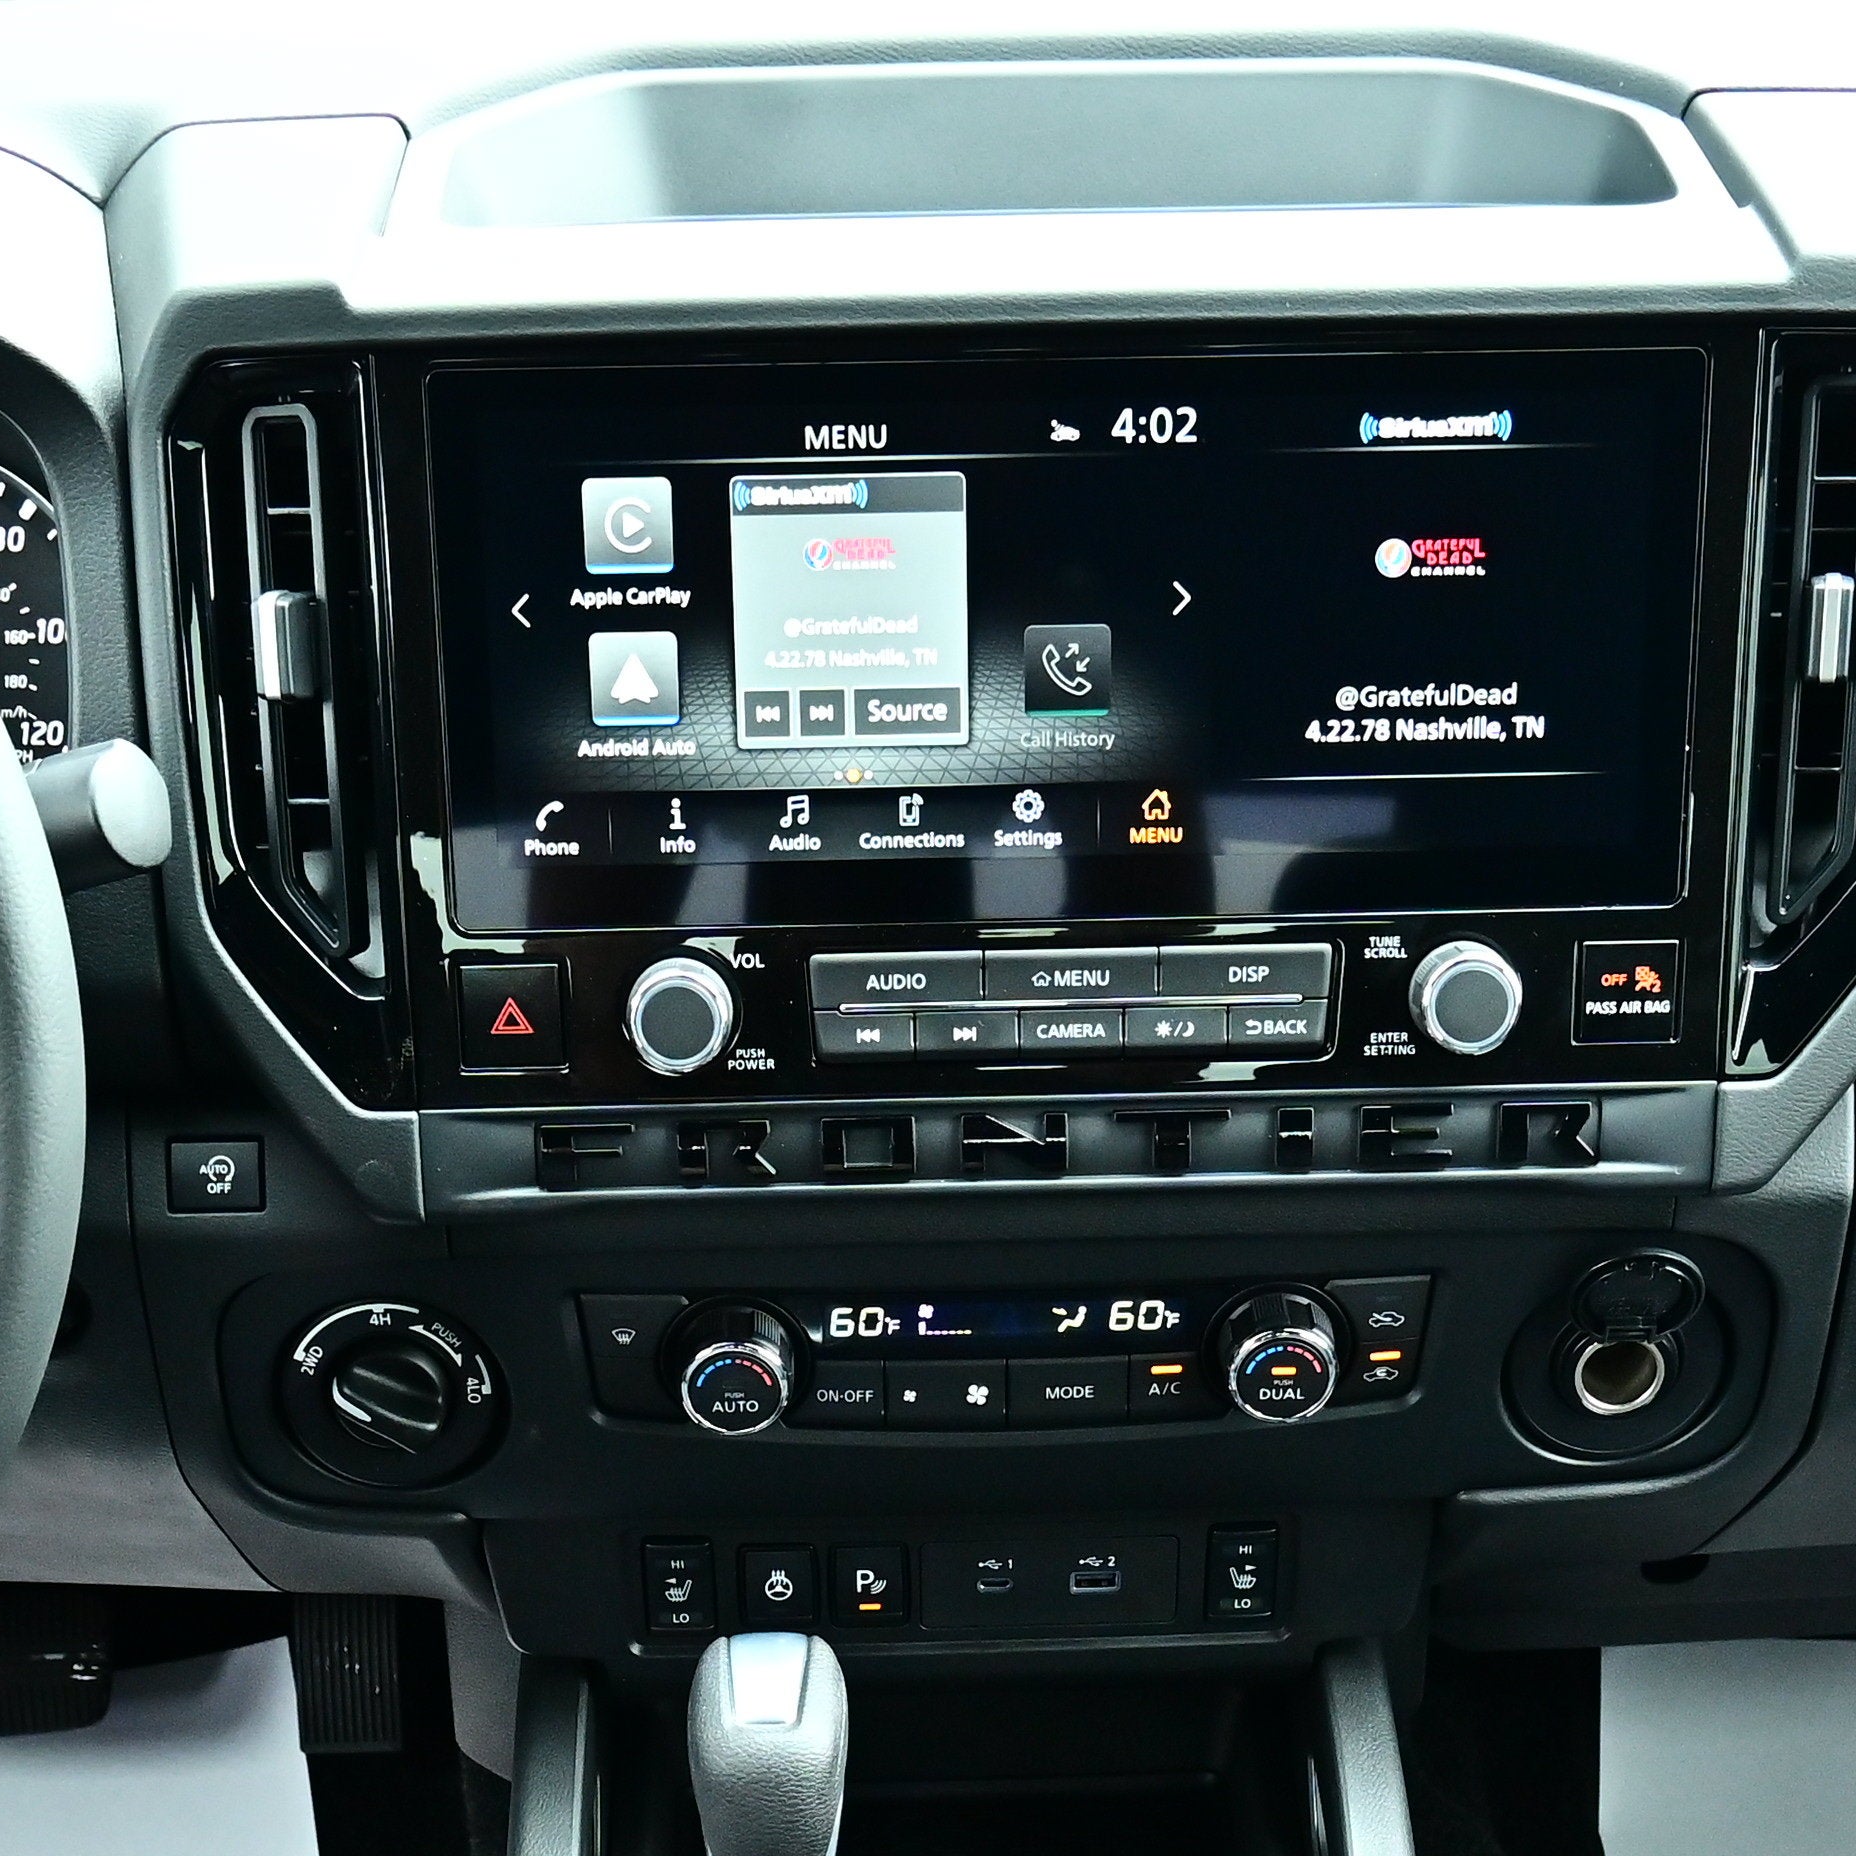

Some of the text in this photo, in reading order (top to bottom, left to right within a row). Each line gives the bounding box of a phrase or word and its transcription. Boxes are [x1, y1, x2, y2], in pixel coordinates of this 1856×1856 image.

[1111, 406, 1198, 444] 4:02
[804, 425, 888, 450] MENU
[1427, 551, 1472, 565] DEAD
[570, 586, 690, 608] Apple CarPlay
[4, 630, 28, 645] 160
[36, 617, 68, 644] 10
[912, 648, 937, 665] TN
[4, 675, 27, 689] 180
[1335, 682, 1518, 710] @GratefulDead
[867, 699, 948, 723] Source
[20, 720, 64, 746] 120
[1305, 716, 1545, 743] 4.22.78 Nashville, TN
[577, 737, 696, 758] Android Auto
[1020, 728, 1115, 751] Call History
[769, 832, 821, 852] Audio
[859, 829, 965, 849] Connections
[993, 826, 1063, 848] Settings
[1129, 825, 1183, 844] MENU
[524, 838, 579, 857] Phone
[660, 835, 696, 855] Info
[1368, 935, 1401, 947] TUNE
[1364, 946, 1408, 959] SCROLL
[730, 953, 765, 970] VOL
[866, 973, 927, 991] AUDIO
[1054, 967, 1110, 988] MENU
[1228, 965, 1270, 984] DISP
[1601, 973, 1628, 987] OFF
[1585, 1000, 1670, 1015] PASS AIR BAG
[1036, 1022, 1106, 1041] CAMERA
[1263, 1018, 1308, 1037] BACK
[1370, 1032, 1408, 1045] ENTER
[735, 1048, 766, 1060] PUSH
[1363, 1043, 1417, 1057] SETTING
[727, 1058, 776, 1072] POWER
[535, 1101, 1602, 1190] FRONTIER
[199, 1164, 229, 1175] AUTO
[206, 1182, 231, 1194] OFF
[369, 1312, 391, 1326] 4H
[431, 1322, 462, 1348] PUSH
[300, 1345, 324, 1376] 2WD
[466, 1377, 482, 1404] 4LO
[1045, 1385, 1094, 1400] MODE
[1148, 1381, 1182, 1397] A/C
[1259, 1387, 1306, 1401] DUAL
[712, 1400, 759, 1414] AUTO
[1238, 1544, 1253, 1556] HI
[671, 1558, 685, 1569] HI
[1007, 1559, 1013, 1570] 1
[1107, 1556, 1116, 1567] 2
[1233, 1597, 1251, 1609] LO
[672, 1612, 689, 1624] LO
